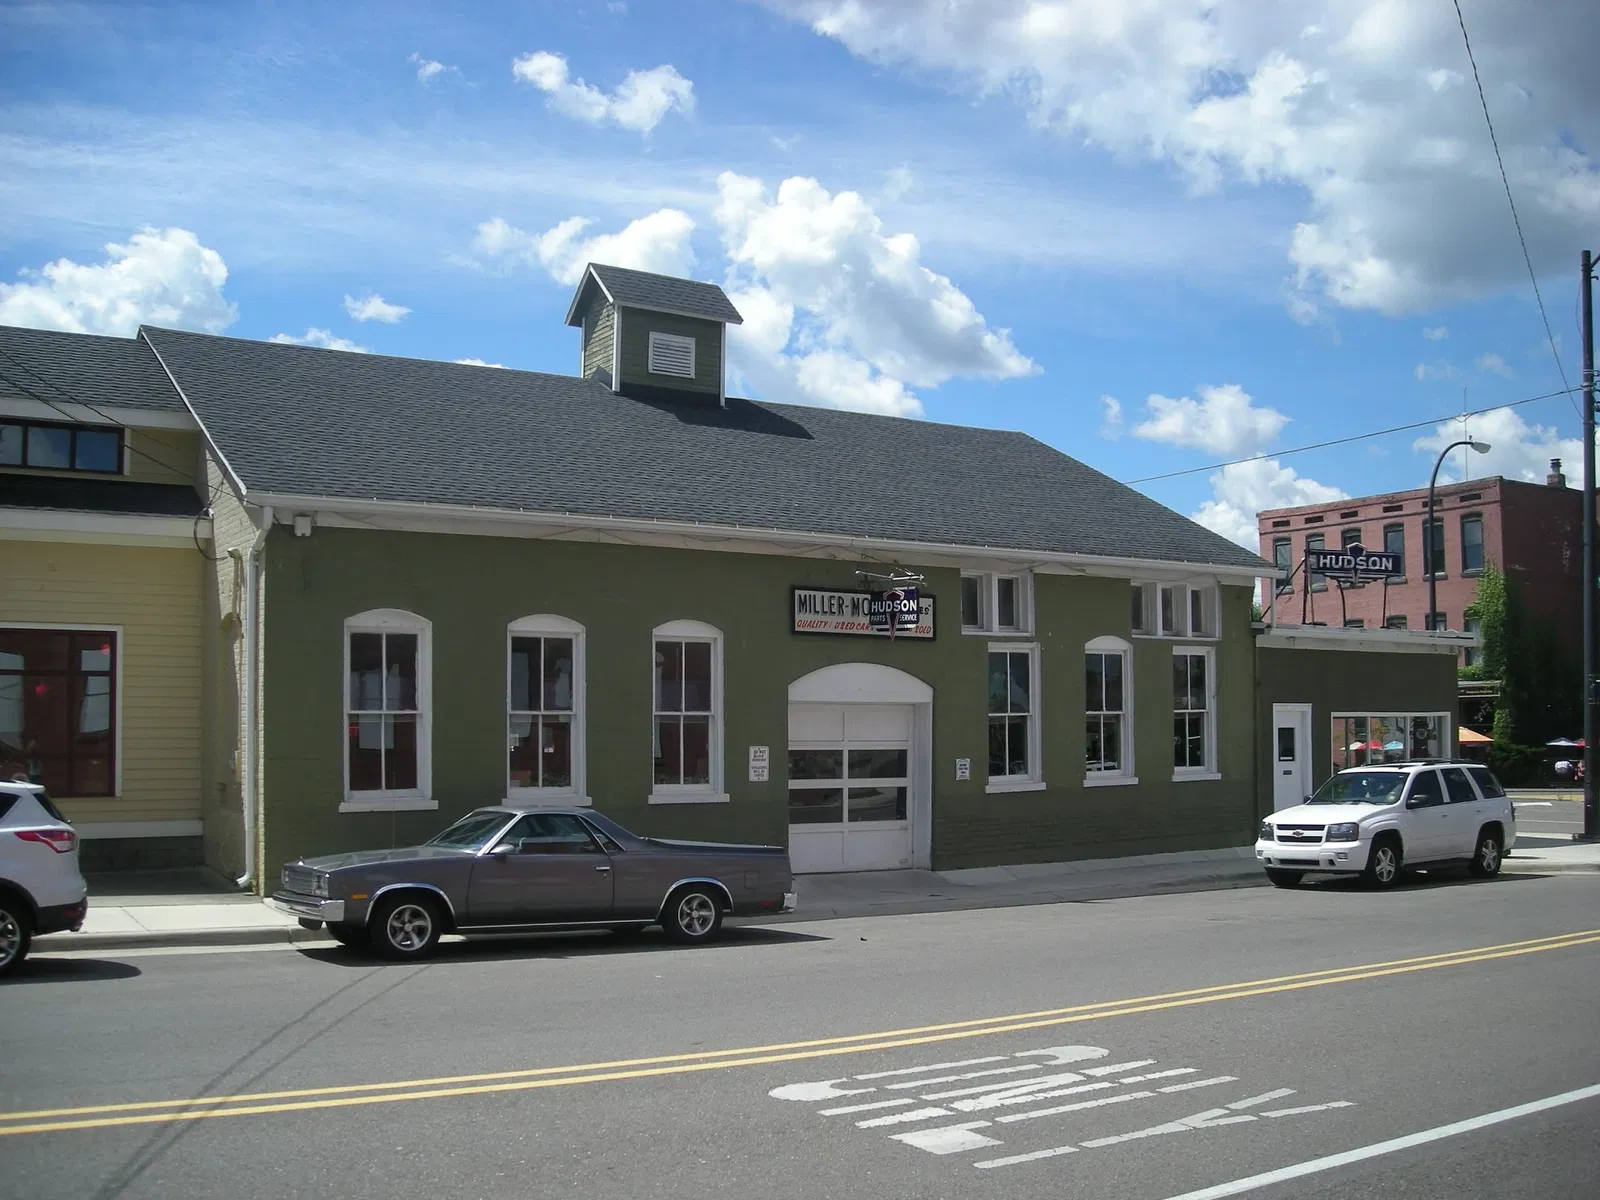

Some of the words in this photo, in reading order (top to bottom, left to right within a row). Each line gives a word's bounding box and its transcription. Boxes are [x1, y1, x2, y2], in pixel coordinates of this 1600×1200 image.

[1319, 554, 1393, 571] HUDSON
[871, 599, 918, 613] HUDSON
[871, 614, 886, 622] PARTS
[899, 613, 917, 622] SERVICE
[796, 619, 829, 629] QUALITY
[835, 621, 855, 631] USED
[915, 625, 932, 635] SOLD
